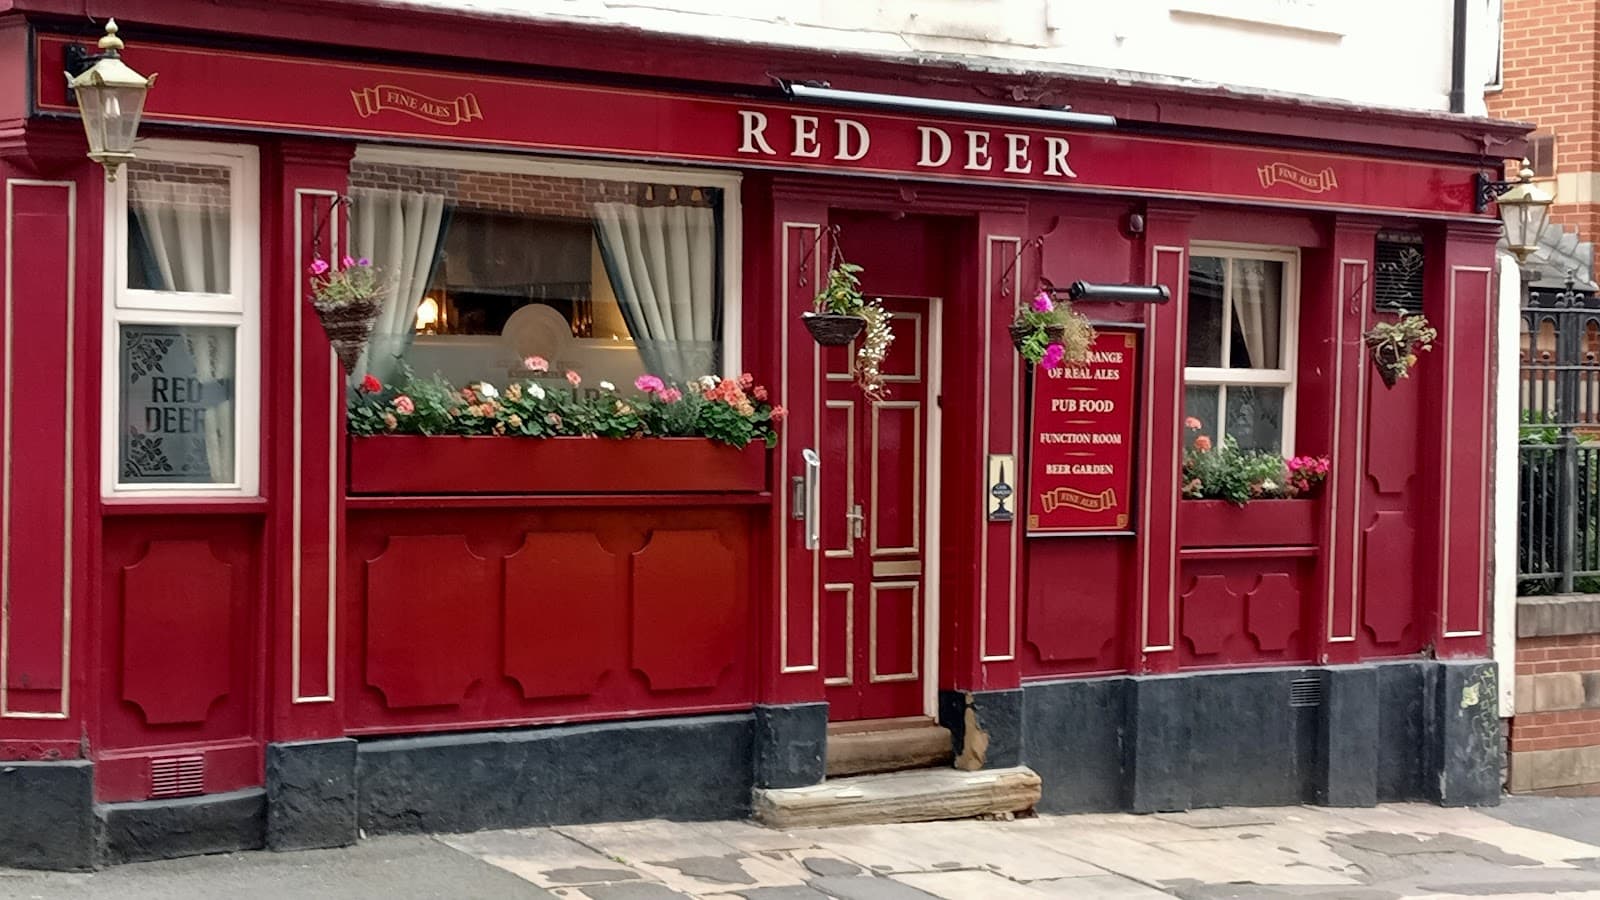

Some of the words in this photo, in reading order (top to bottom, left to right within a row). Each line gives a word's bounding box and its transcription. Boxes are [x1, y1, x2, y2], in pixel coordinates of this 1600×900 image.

[387, 92, 417, 109] FINE
[420, 102, 451, 117] ALES
[738, 110, 870, 161] RED
[917, 126, 1077, 178] DEER
[1048, 368, 1063, 379] OF
[1064, 369, 1092, 380] REAL
[1094, 369, 1120, 380] ALES
[1051, 399, 1077, 412] PUB
[1079, 399, 1115, 413] FOOD
[1040, 433, 1091, 444] FUNCTION
[1092, 433, 1122, 444] ROOM
[1046, 464, 1071, 475] BEER
[1072, 464, 1114, 475] GARDEN
